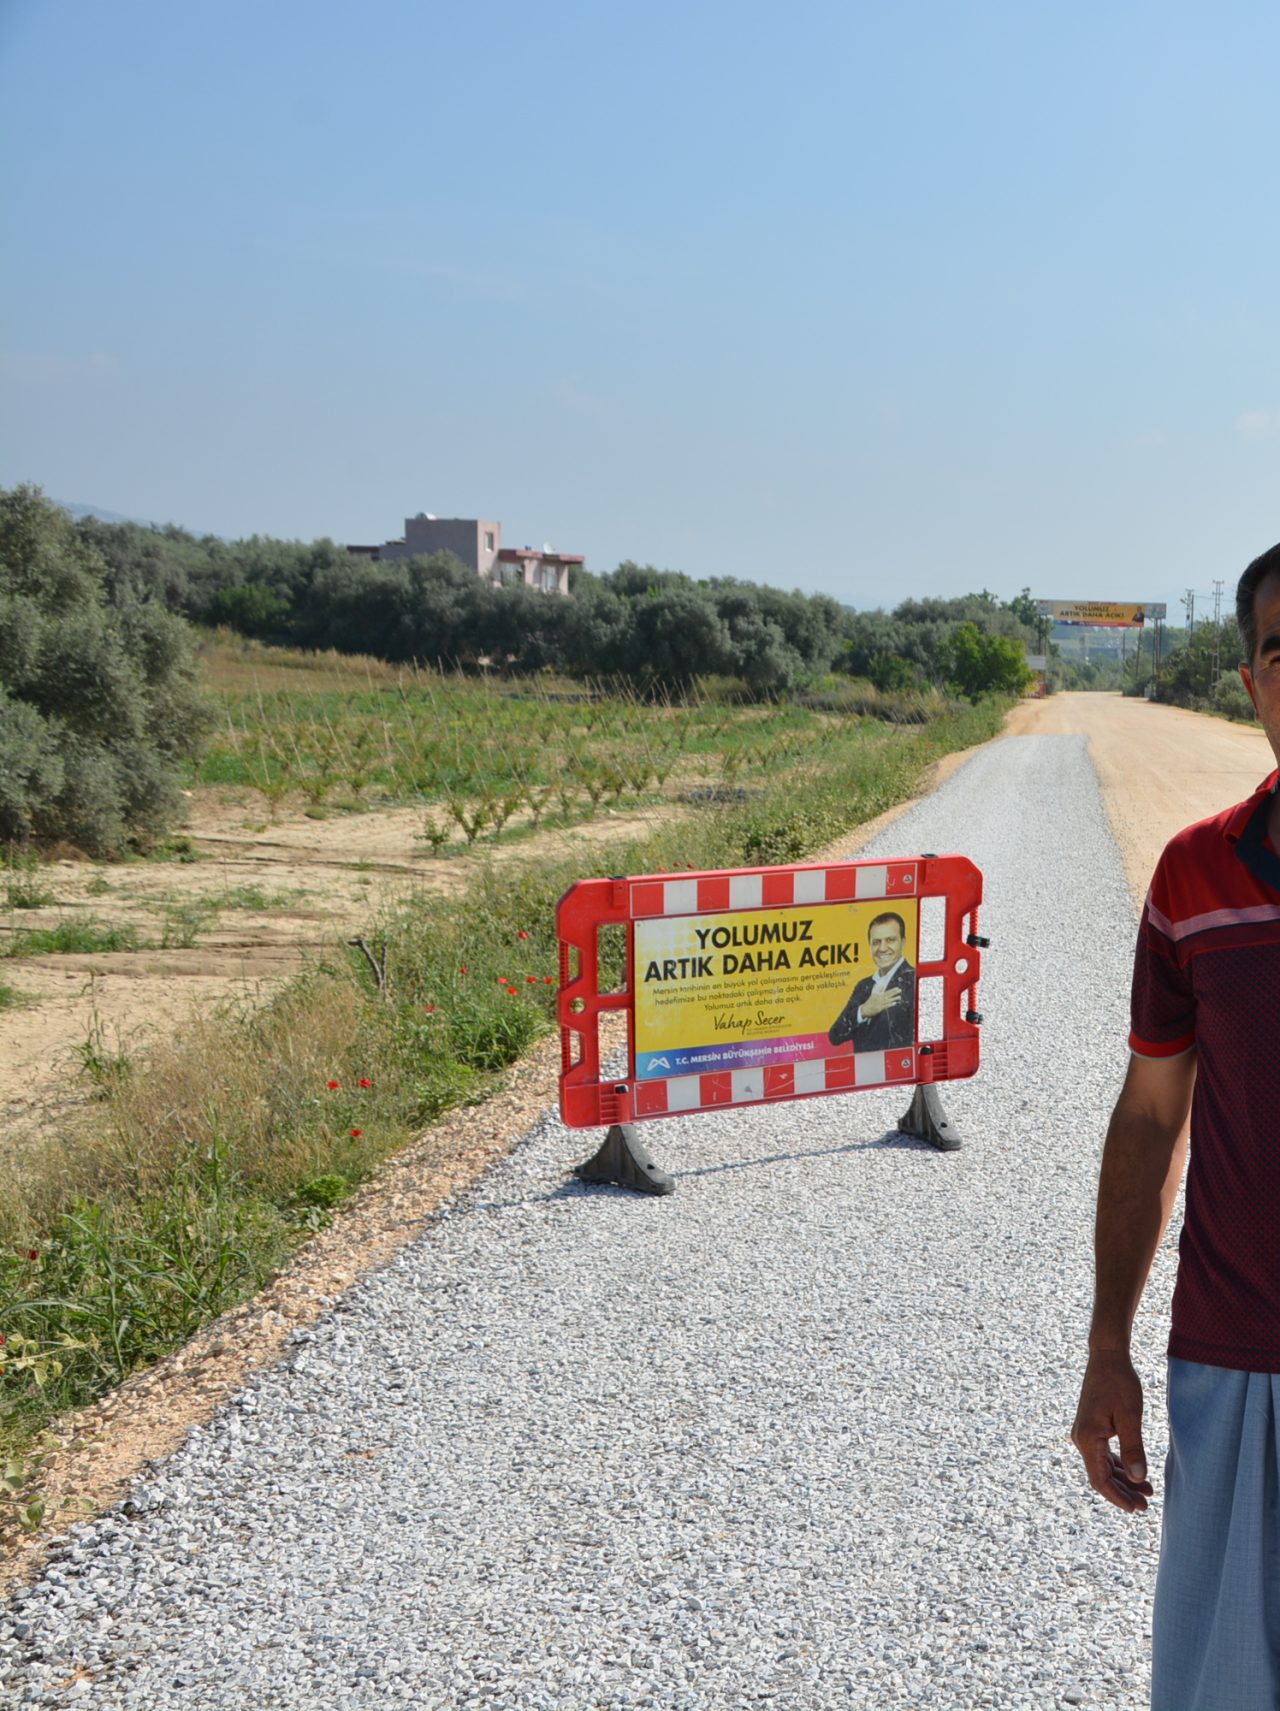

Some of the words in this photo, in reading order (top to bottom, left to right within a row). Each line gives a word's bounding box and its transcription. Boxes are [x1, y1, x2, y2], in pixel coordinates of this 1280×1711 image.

[695, 920, 813, 949] YOLUMUZ
[644, 956, 714, 982] ARTIK
[722, 949, 791, 975] DAHA
[798, 943, 860, 968] AÇIK!
[680, 984, 711, 993] tarihinin
[724, 979, 746, 988] büyük
[747, 978, 759, 987] yol
[760, 976, 799, 986] çalışmasını
[801, 970, 851, 982] gerçekleştirme
[655, 996, 695, 1006] hedefimize
[709, 991, 745, 1000] noktadaki
[786, 984, 804, 993] daha
[704, 1002, 735, 1011] Yolumuz
[736, 999, 752, 1008] artık
[754, 998, 773, 1006] daha
[714, 1012, 752, 1035] Vahap
[675, 1057, 689, 1066] T.C.
[690, 1052, 721, 1064] MERSİN
[723, 1047, 772, 1060] BÜYÜKŞEHİR
[773, 1040, 815, 1054] BELEDİYESİ
